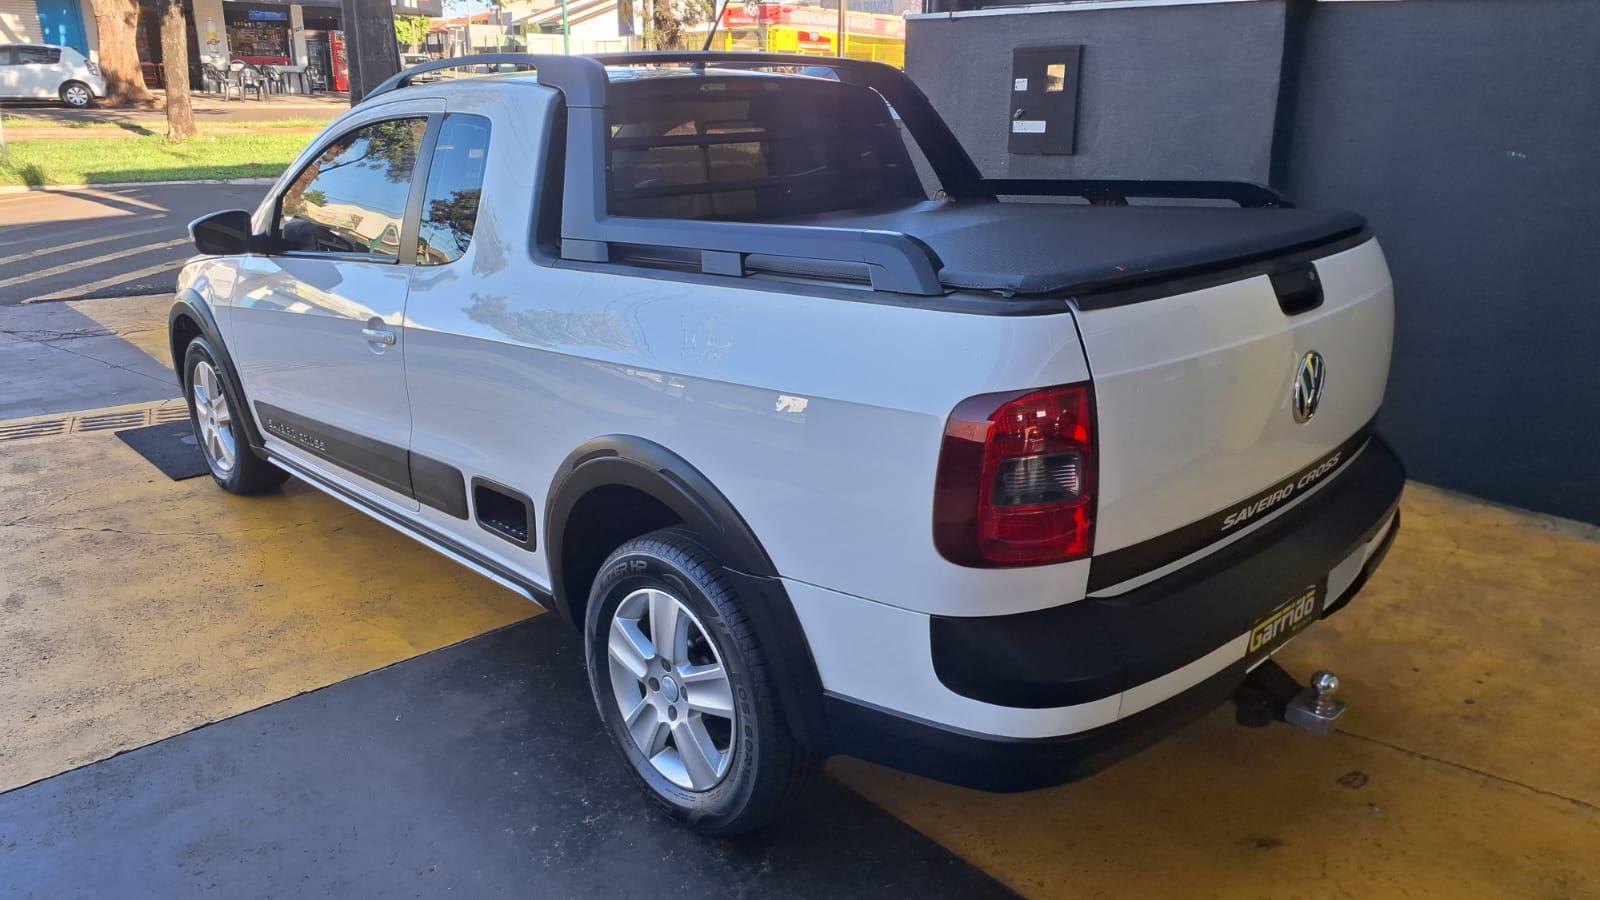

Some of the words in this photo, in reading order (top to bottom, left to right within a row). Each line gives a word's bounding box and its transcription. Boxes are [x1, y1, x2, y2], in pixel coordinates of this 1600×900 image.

[1221, 483, 1295, 531] SAVEIRO
[1297, 451, 1342, 489] CROSS
[630, 560, 648, 573] HP
[1250, 588, 1317, 653] Garrido
